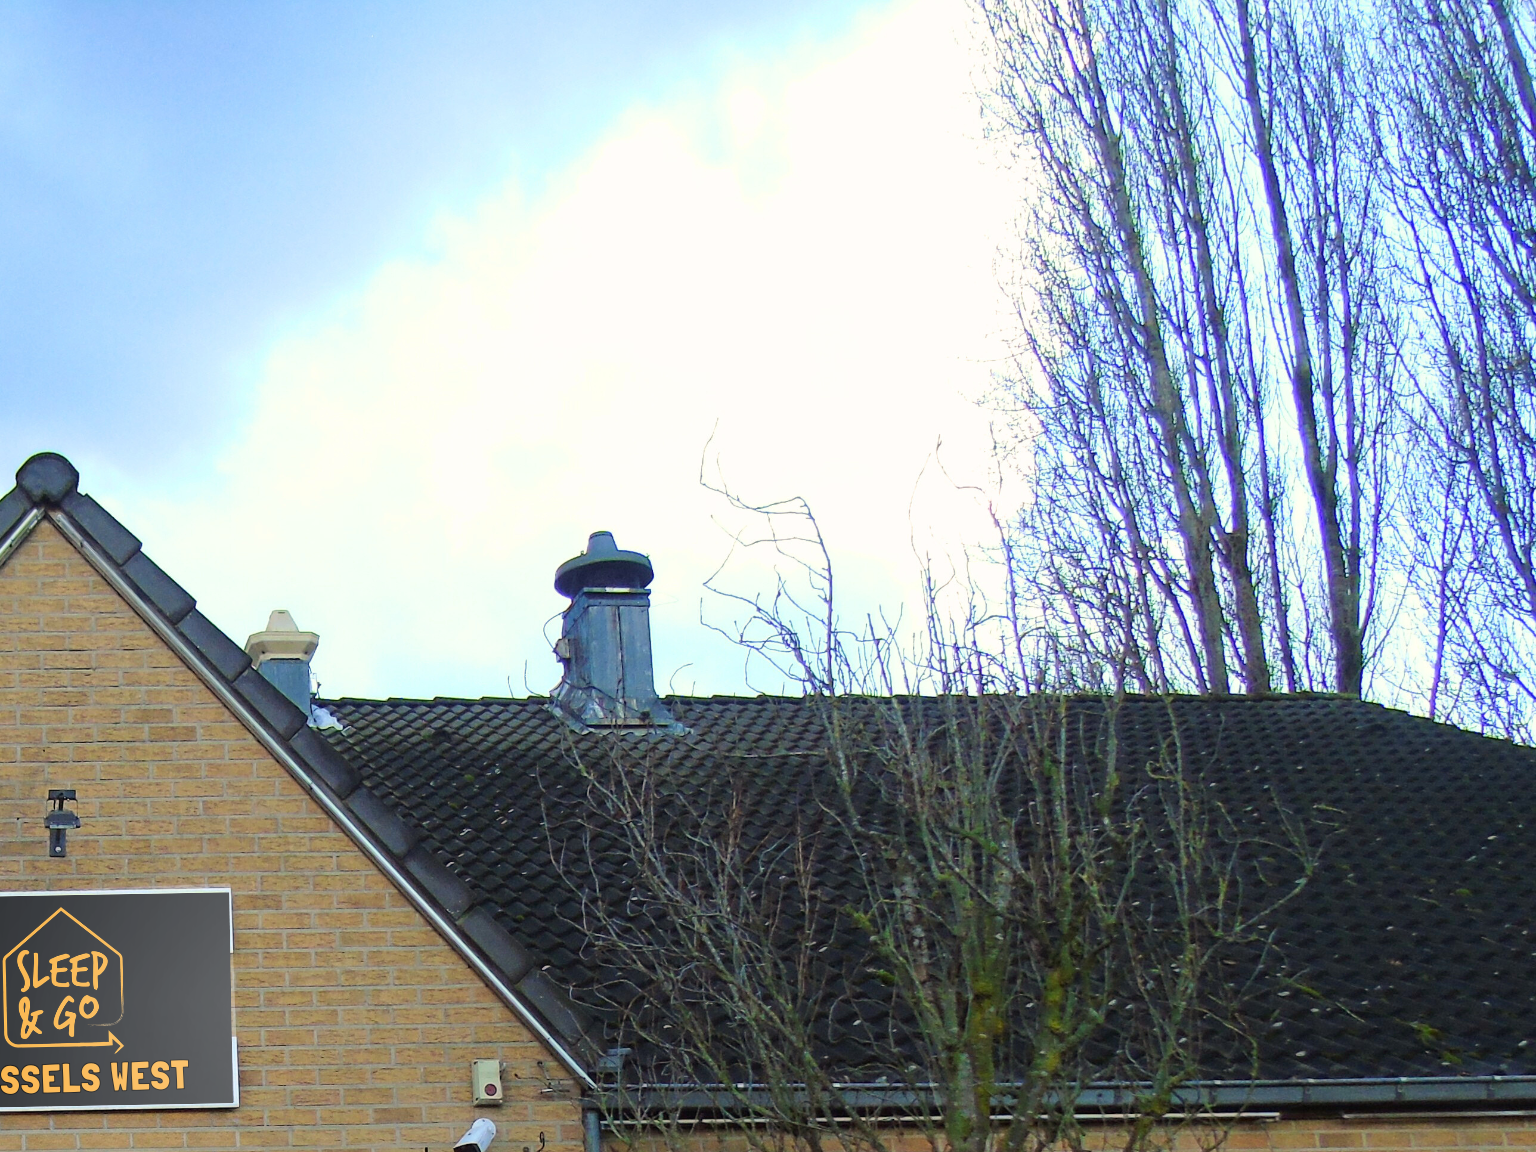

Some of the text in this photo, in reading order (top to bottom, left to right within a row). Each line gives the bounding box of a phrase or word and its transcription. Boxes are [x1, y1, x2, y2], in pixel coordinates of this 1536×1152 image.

[17, 950, 108, 992] SLEEP
[18, 995, 100, 1040] & GO
[111, 1060, 189, 1092] WEST
